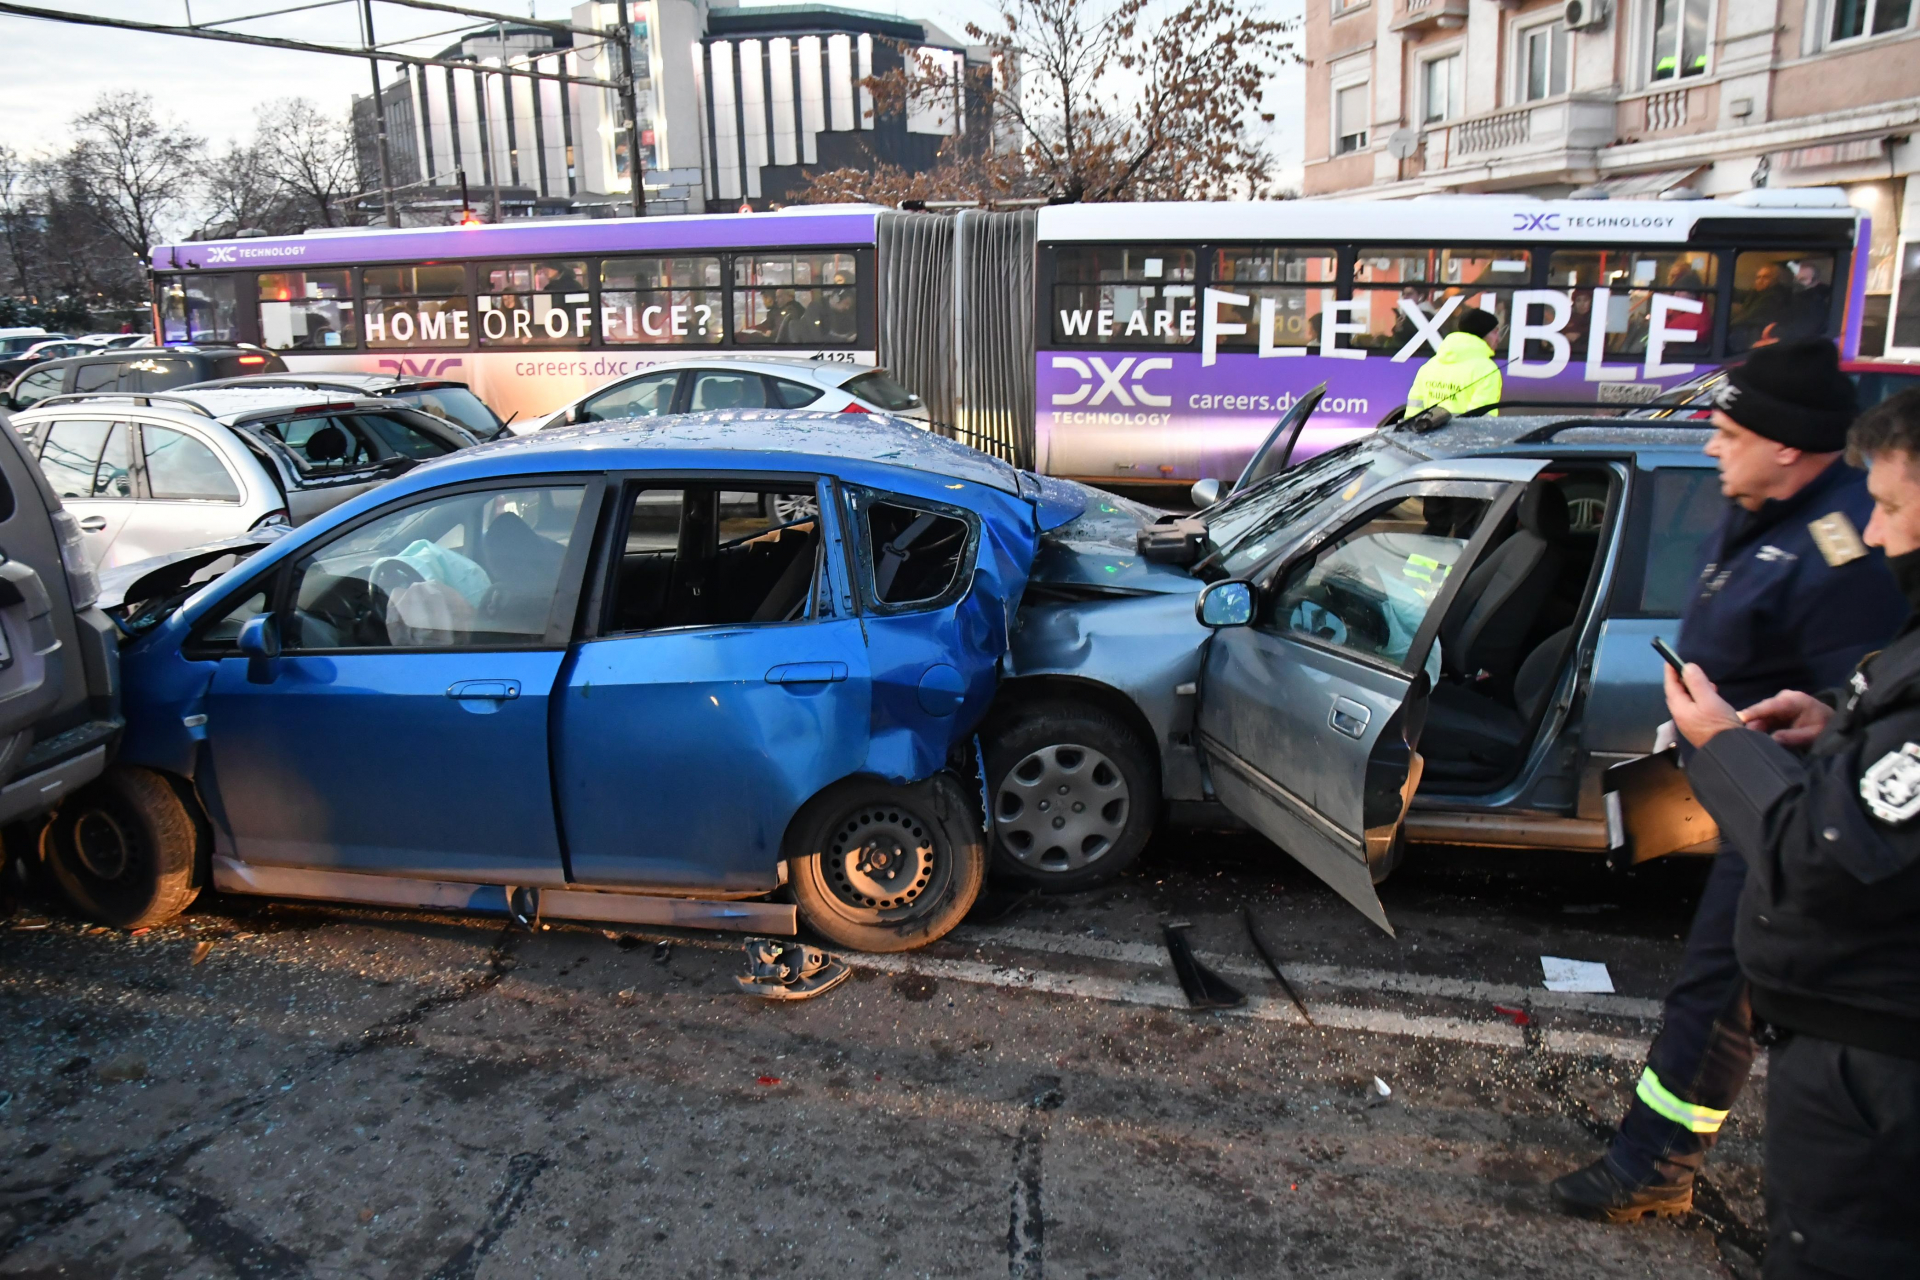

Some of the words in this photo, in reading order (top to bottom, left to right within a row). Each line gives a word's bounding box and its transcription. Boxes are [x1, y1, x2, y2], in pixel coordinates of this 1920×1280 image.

[1513, 214, 1560, 231] DXC
[1567, 217, 1674, 228] TECHNOLOGY
[207, 246, 237, 263] DXC
[239, 246, 306, 258] TECHNOLOGY
[365, 311, 469, 341] HOME
[483, 309, 533, 339] OR
[544, 304, 712, 338] OFFICE?
[1060, 310, 1113, 336] WE
[1125, 310, 1196, 336] ARE
[1202, 287, 1704, 381] FLEXBLE
[1052, 356, 1173, 407] DXC
[1189, 391, 1368, 413] careers.d.com
[1052, 411, 1171, 426] TECHNOLOGY
